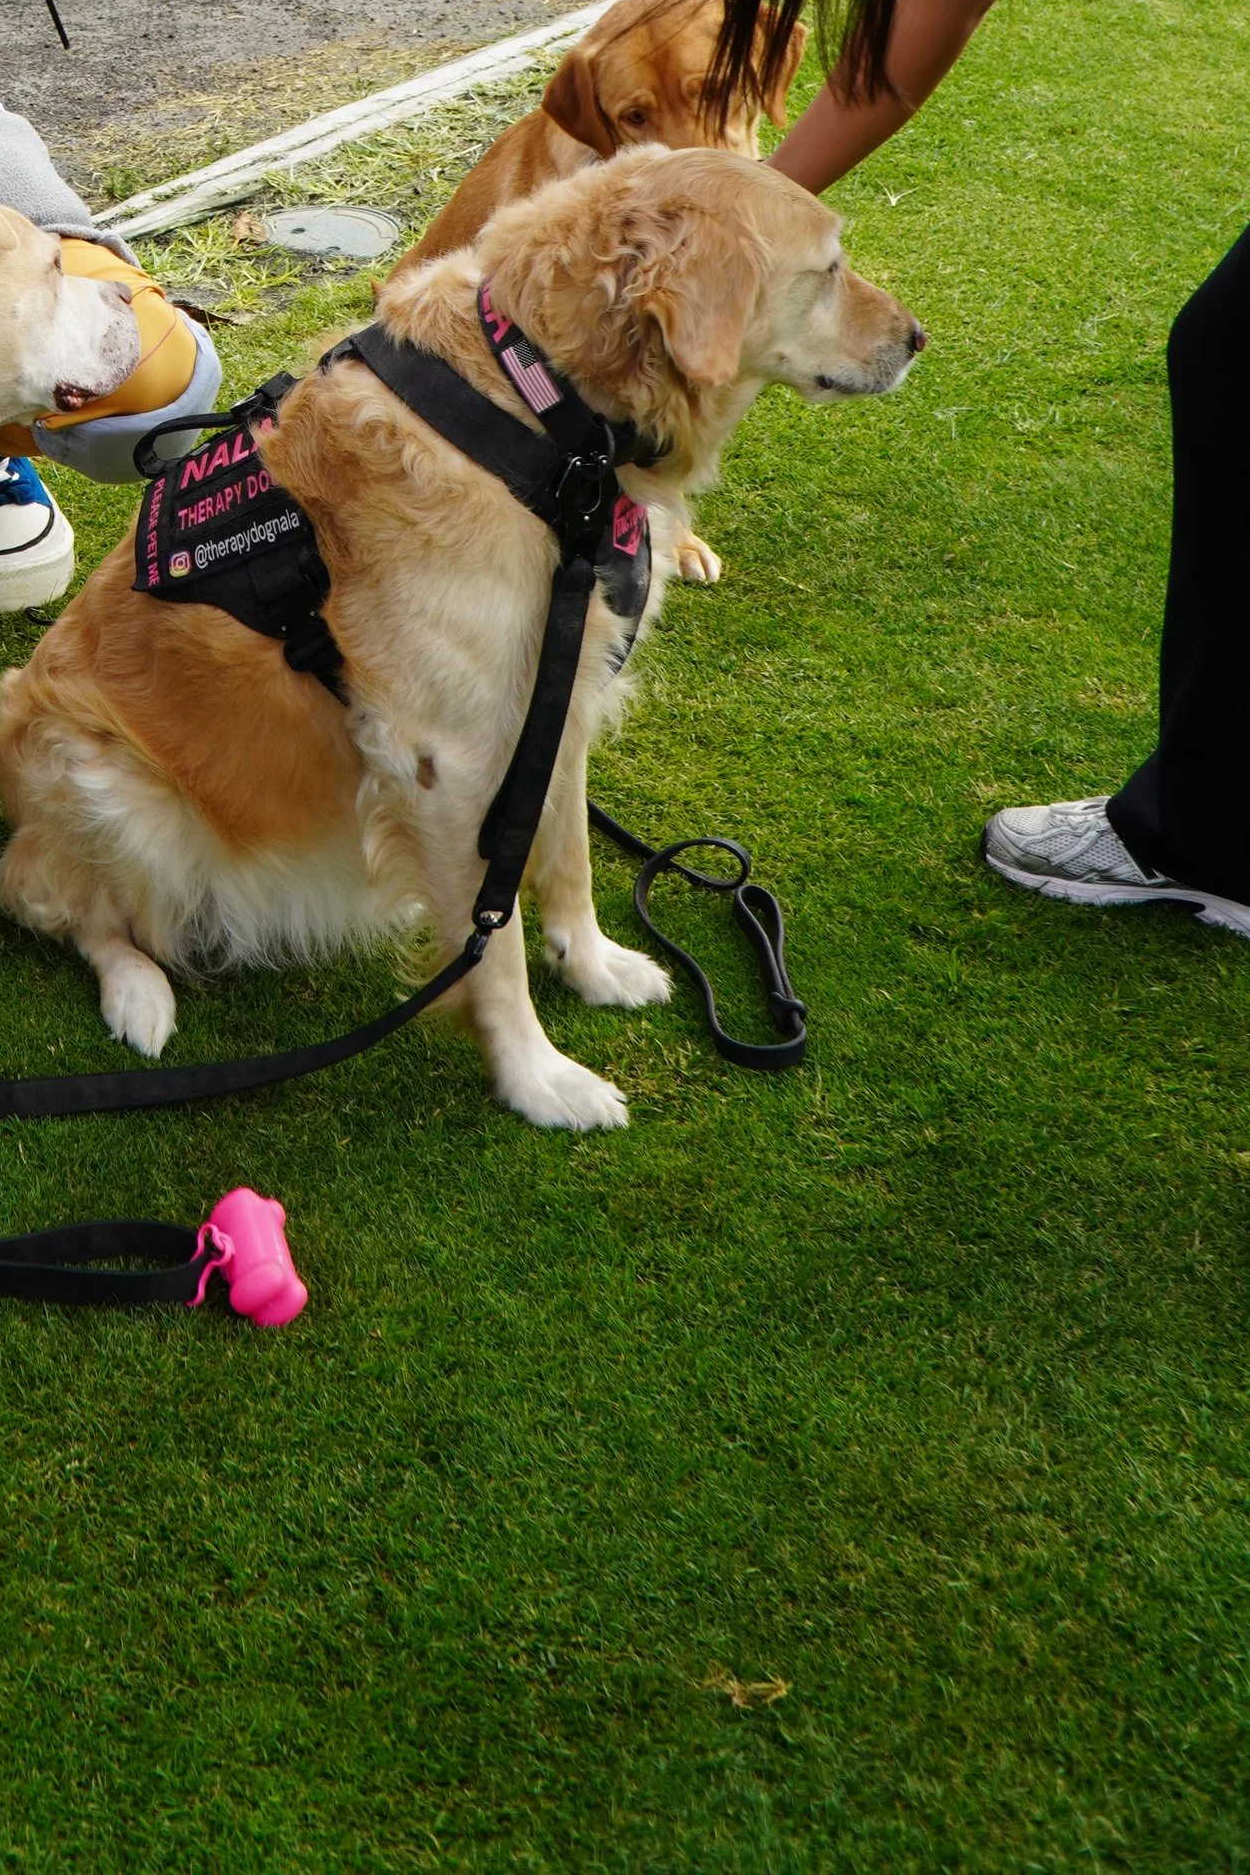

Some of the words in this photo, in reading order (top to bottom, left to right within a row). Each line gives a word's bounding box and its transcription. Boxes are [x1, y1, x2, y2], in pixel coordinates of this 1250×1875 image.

[147, 477, 166, 530] PLEASE
[177, 481, 243, 531] THERAPY
[146, 531, 158, 560] PET
[194, 508, 300, 570] @therapydognala
[148, 563, 161, 588] ME
